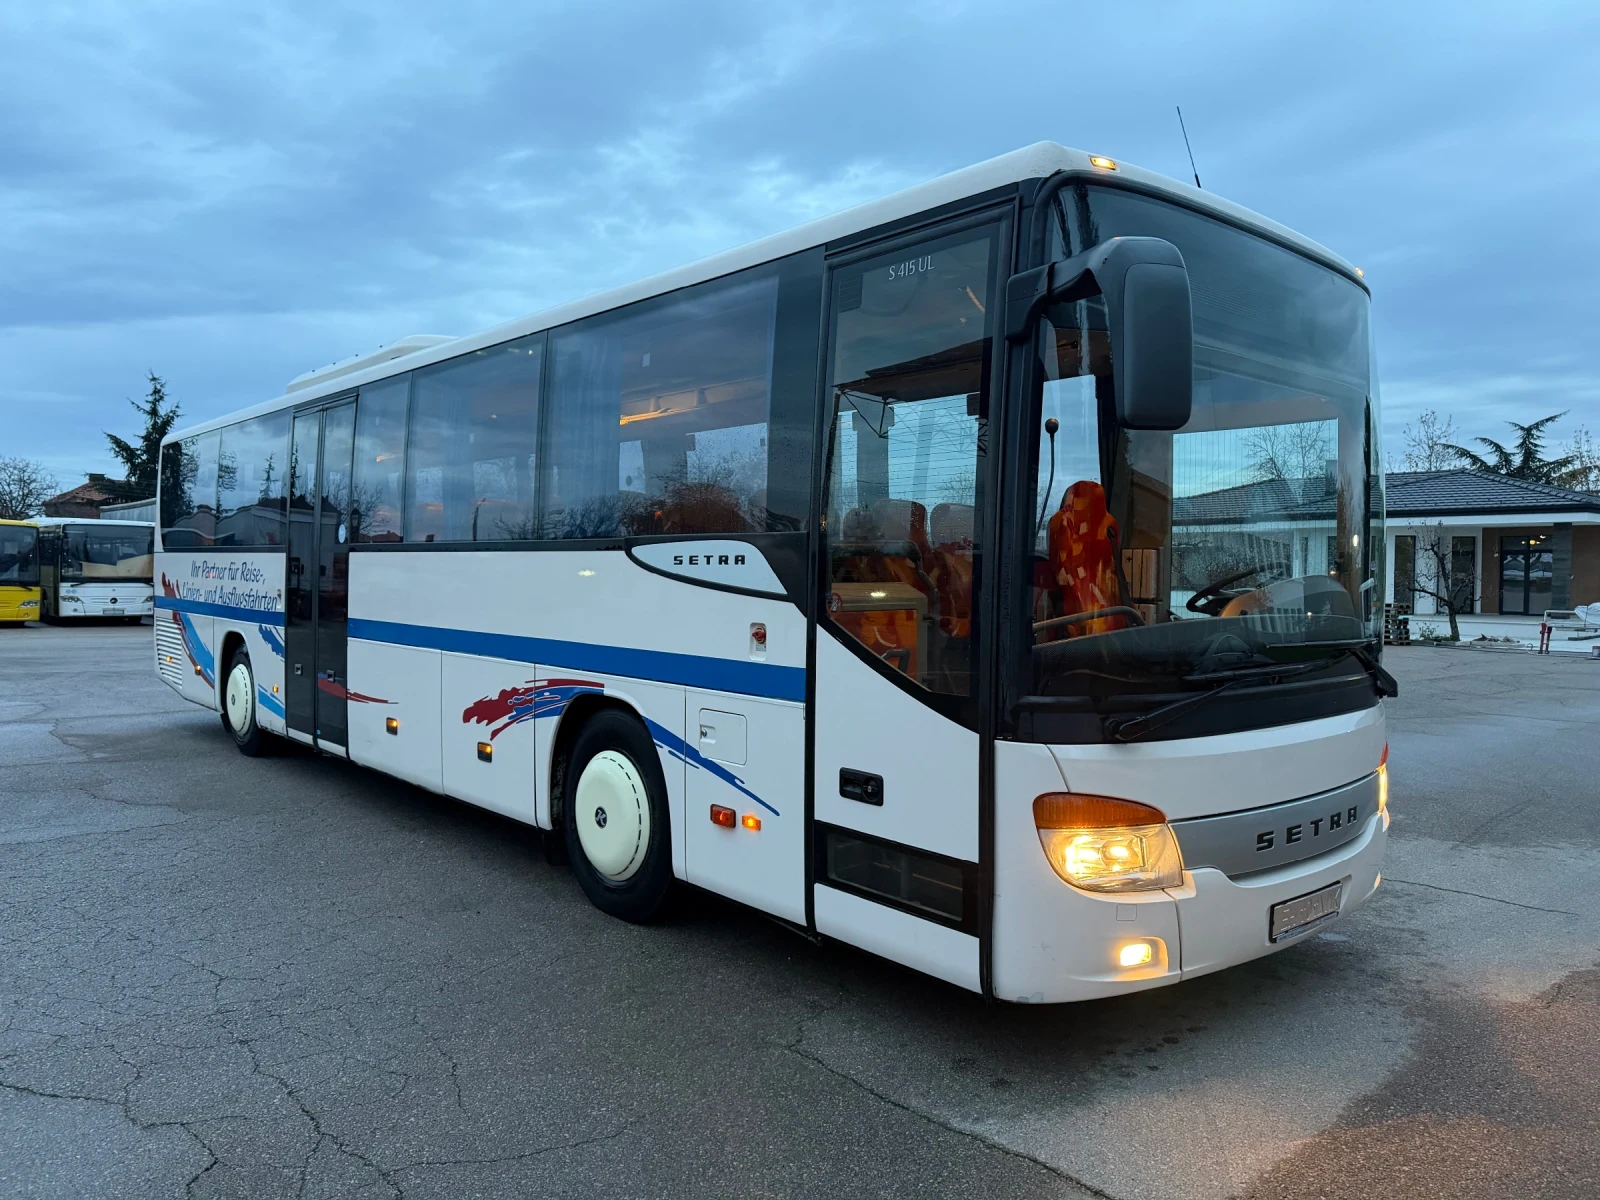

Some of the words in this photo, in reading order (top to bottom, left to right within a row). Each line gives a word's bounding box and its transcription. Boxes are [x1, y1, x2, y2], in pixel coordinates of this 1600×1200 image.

[888, 265, 896, 280] S
[897, 259, 916, 277] 415
[918, 255, 935, 272] UL
[190, 560, 201, 578] Ihr
[201, 560, 227, 580] Partner
[228, 562, 240, 581] für
[673, 554, 746, 566] SETRA
[182, 581, 203, 599] Linien-
[204, 585, 218, 603] und
[218, 585, 277, 611] Ausflugsfahrten
[1255, 804, 1358, 852] SETRA
